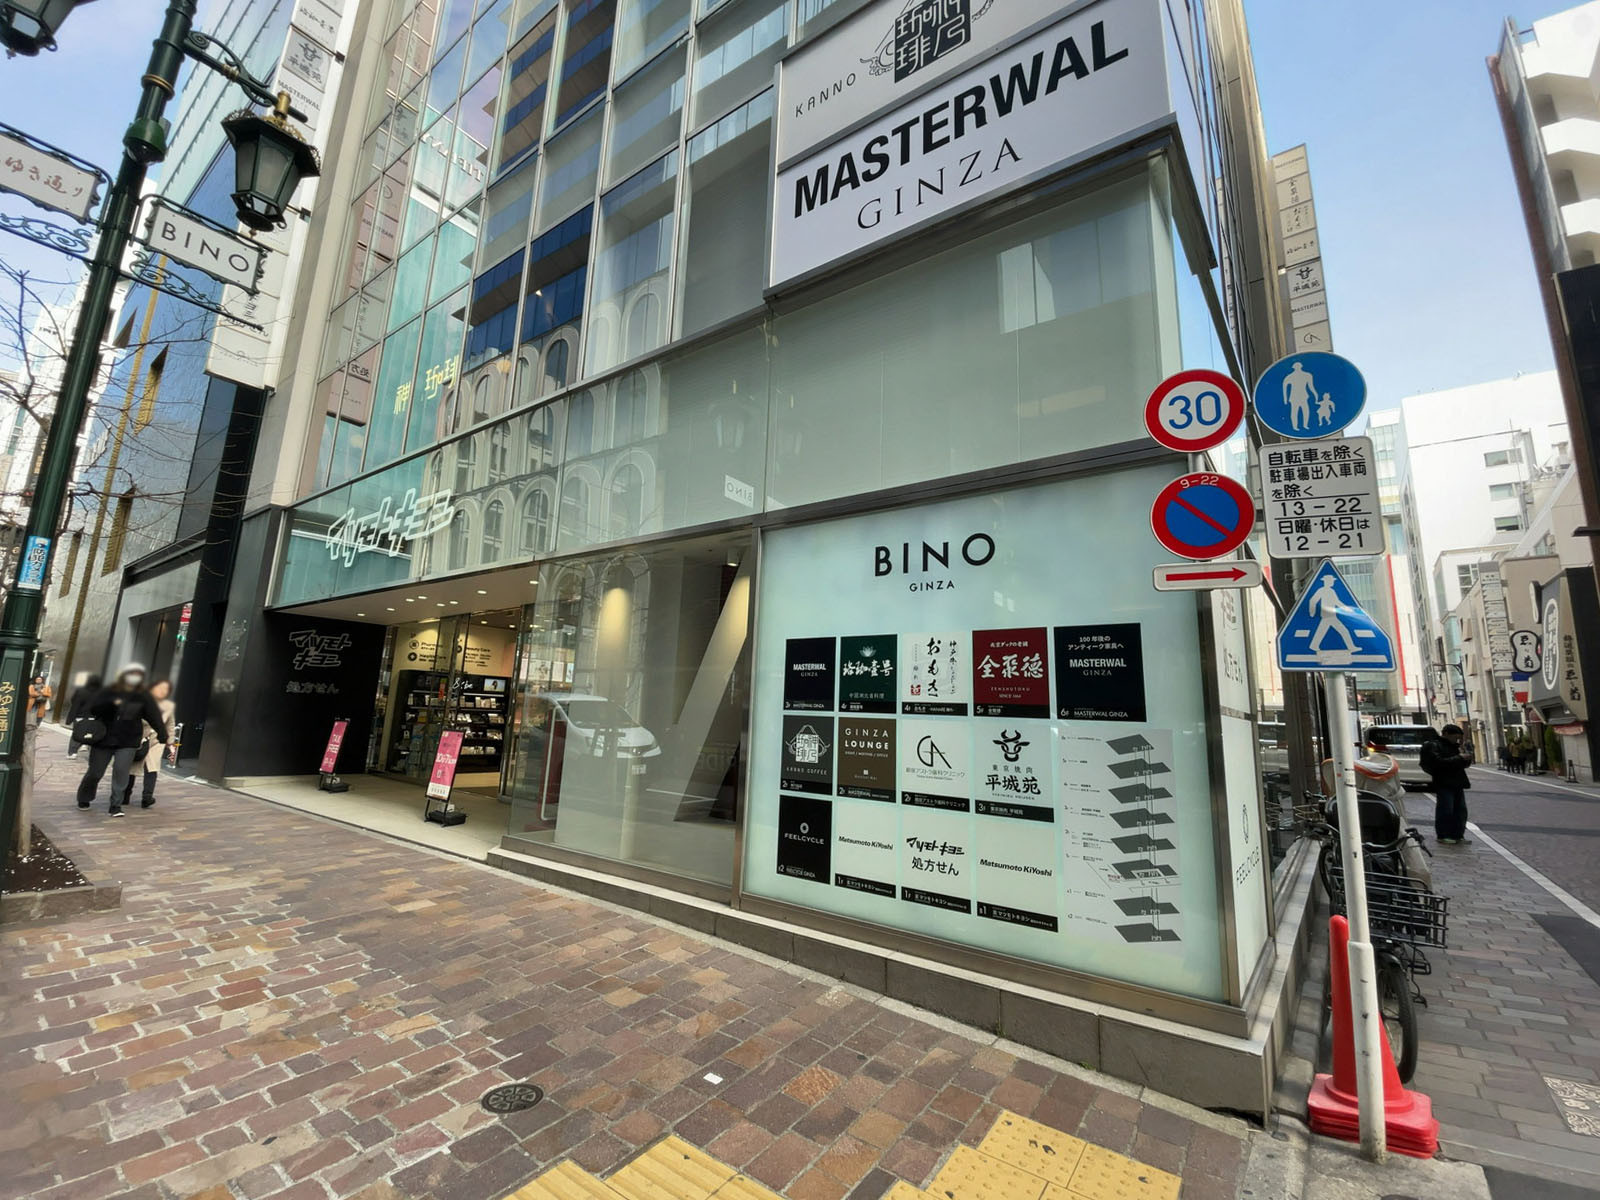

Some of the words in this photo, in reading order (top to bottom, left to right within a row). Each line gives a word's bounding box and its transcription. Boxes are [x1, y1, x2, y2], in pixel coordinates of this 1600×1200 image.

[795, 72, 857, 118] KANNO
[794, 20, 1129, 219] MASTERWAL
[856, 137, 1023, 230] GINZA
[160, 221, 251, 273] BINO
[1168, 390, 1222, 430] 30
[1267, 445, 1365, 467] 自転車を除く
[1180, 475, 1220, 489] 9-22
[1269, 460, 1368, 484] 駐車場出入車両
[1271, 483, 1314, 499] を除く
[874, 532, 996, 578] BINO
[908, 578, 956, 592] GINZA
[793, 663, 827, 671] MASTERWAL
[1069, 658, 1127, 668] MASTERWAL
[845, 728, 889, 738] GINZA
[844, 740, 889, 750] LOUNGE
[985, 774, 1042, 796] 平城苑
[784, 832, 825, 845] FEELCYCLE
[906, 836, 965, 856] マツモトキヨシ
[911, 856, 960, 877] 処方せん
[980, 858, 1024, 872] Matsumoto
[1023, 865, 1053, 878] KiYoshi
